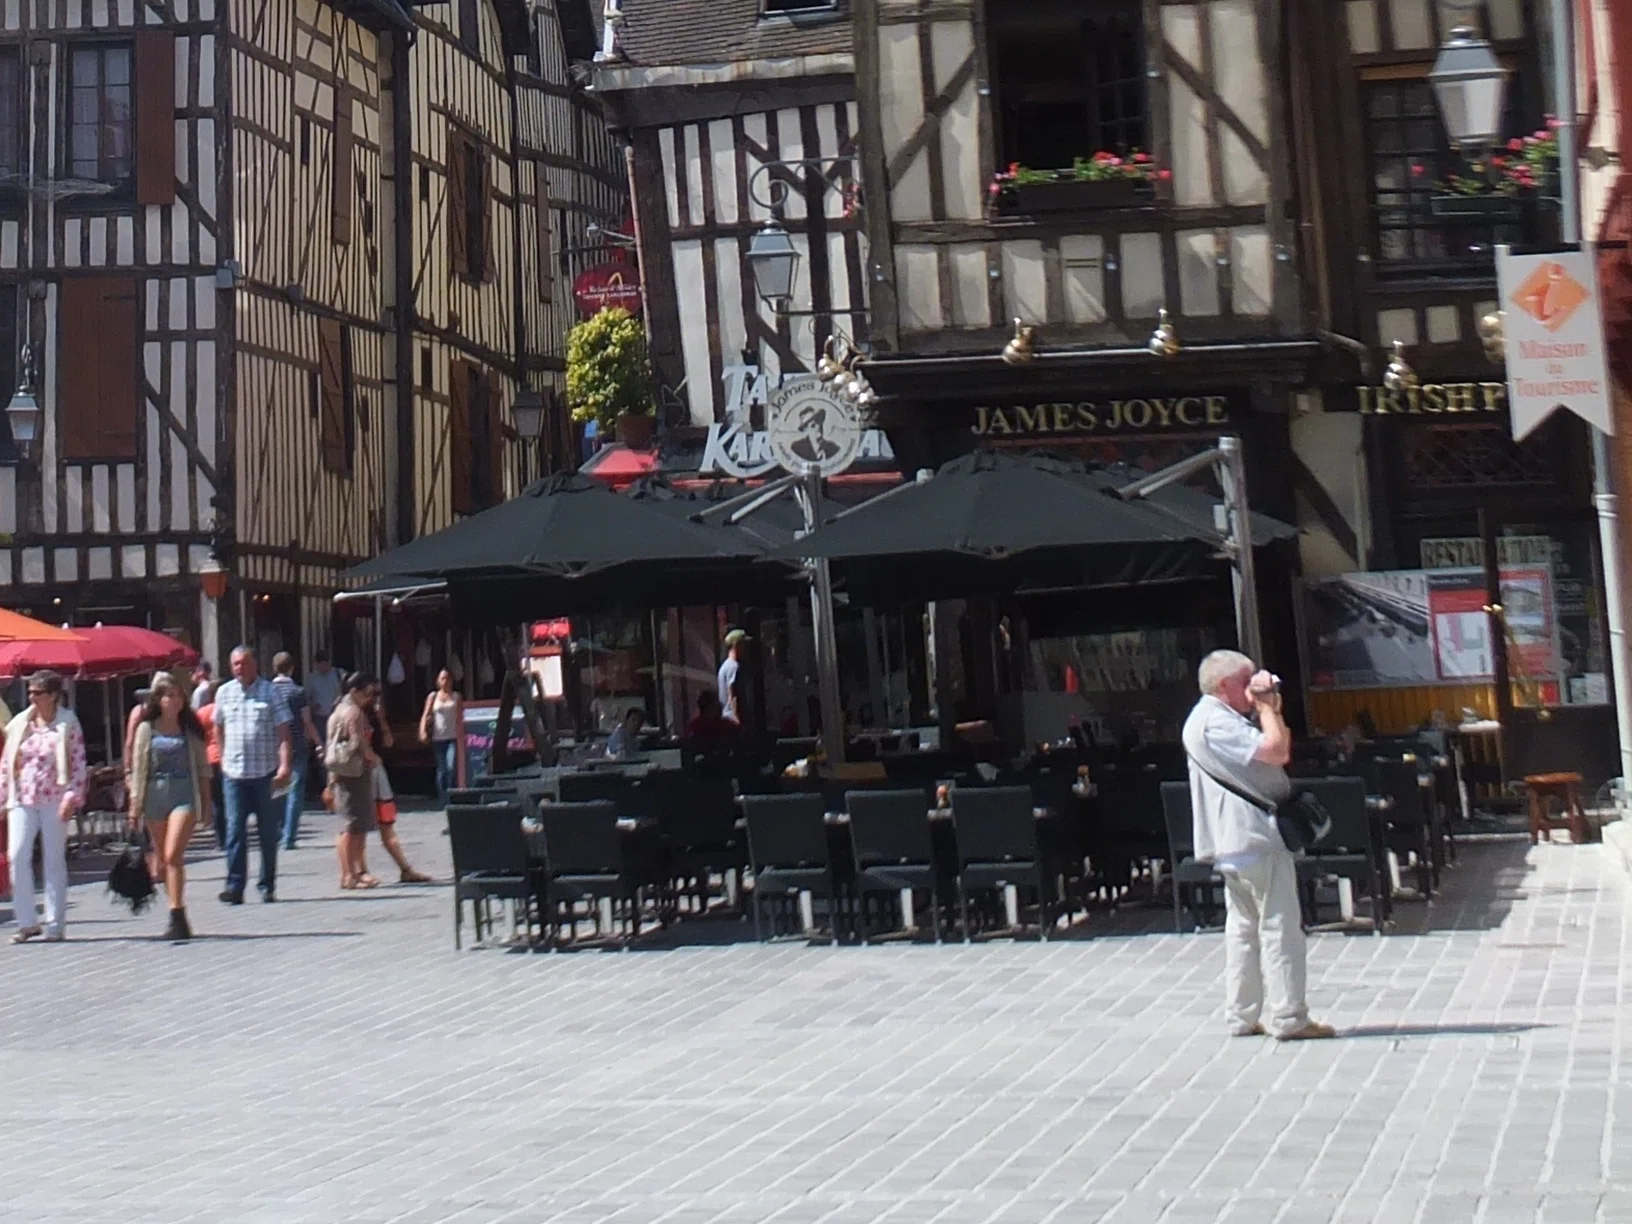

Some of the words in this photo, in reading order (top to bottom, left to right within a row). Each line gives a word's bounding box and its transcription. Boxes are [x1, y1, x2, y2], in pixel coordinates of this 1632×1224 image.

[1519, 339, 1588, 359] Maison
[1356, 382, 1478, 415] IRISH
[1513, 377, 1599, 398] Tourisme
[970, 401, 1097, 436] JAMES
[1105, 395, 1230, 429] JOYCE
